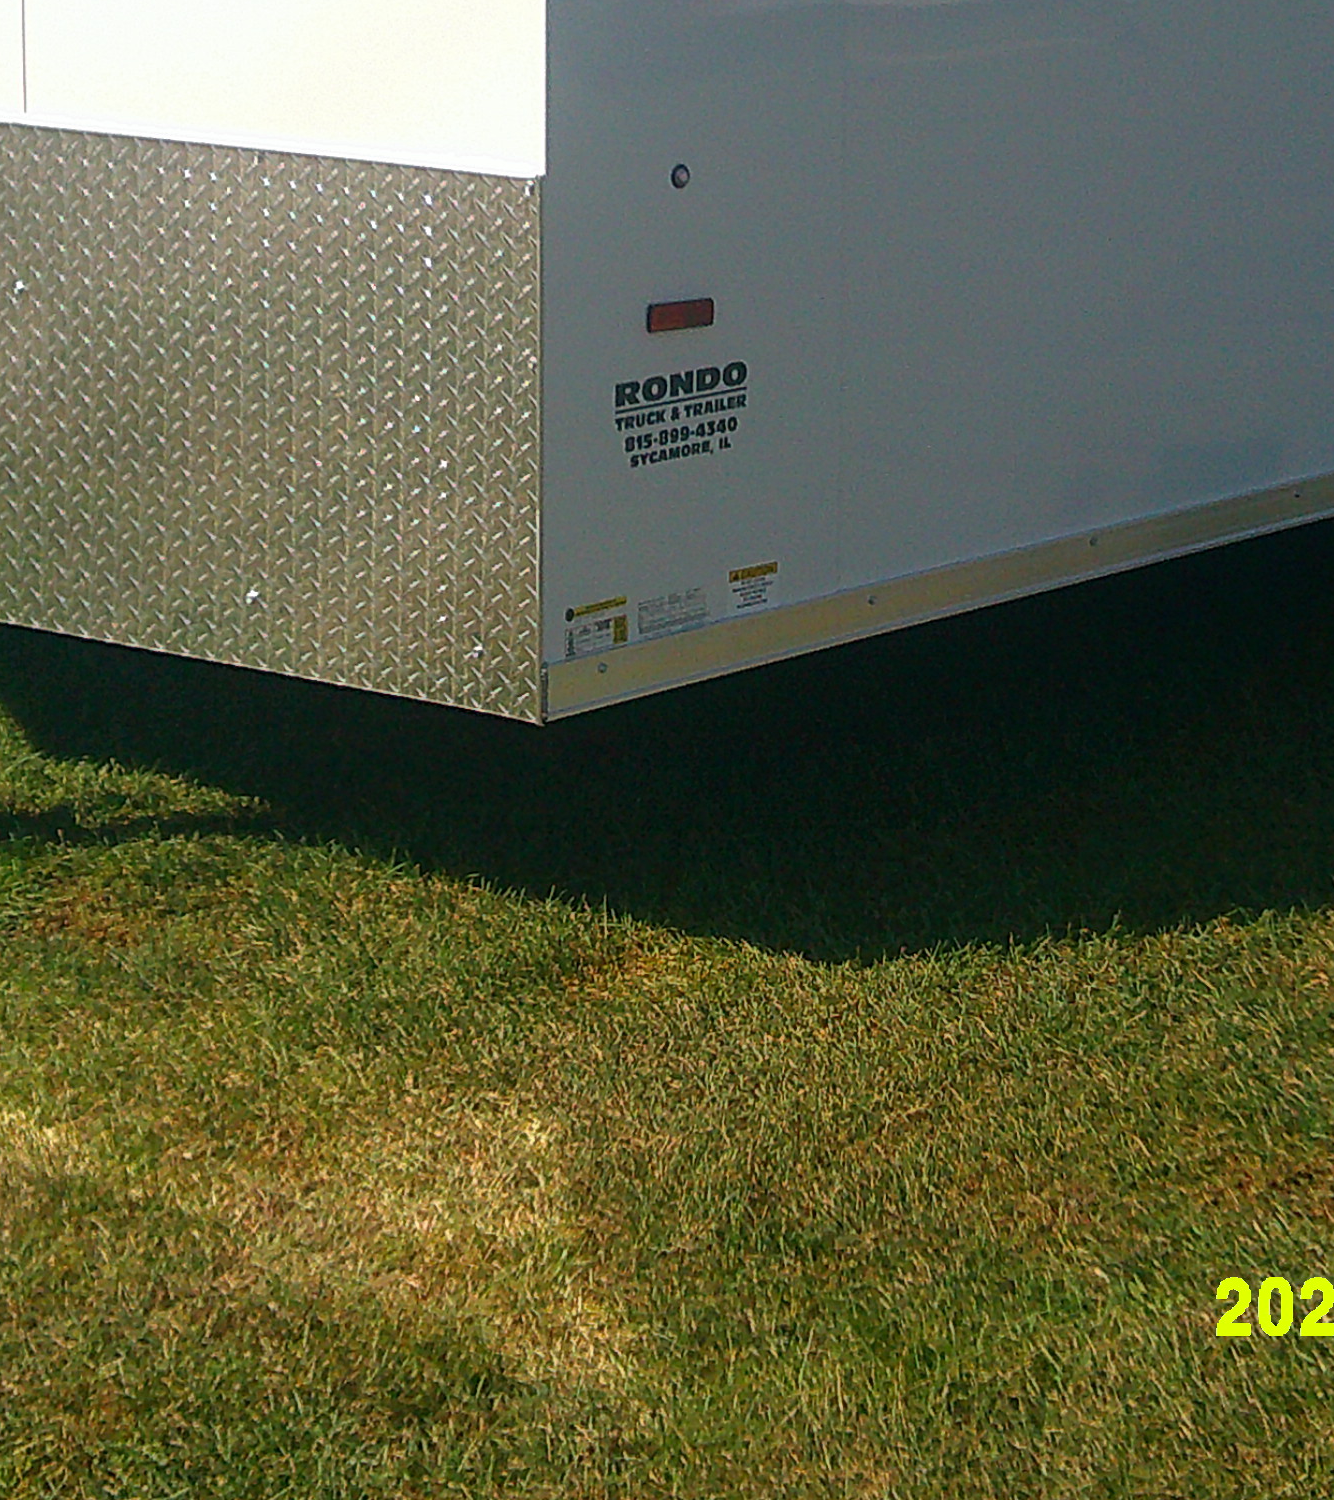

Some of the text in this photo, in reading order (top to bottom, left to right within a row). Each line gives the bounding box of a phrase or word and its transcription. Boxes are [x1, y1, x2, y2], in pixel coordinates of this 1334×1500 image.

[615, 361, 748, 407] RONDO
[615, 394, 747, 432] TRUCK & TRAILER
[624, 417, 738, 453] 815-899-4340
[630, 436, 732, 468] SYCAMORE, IL
